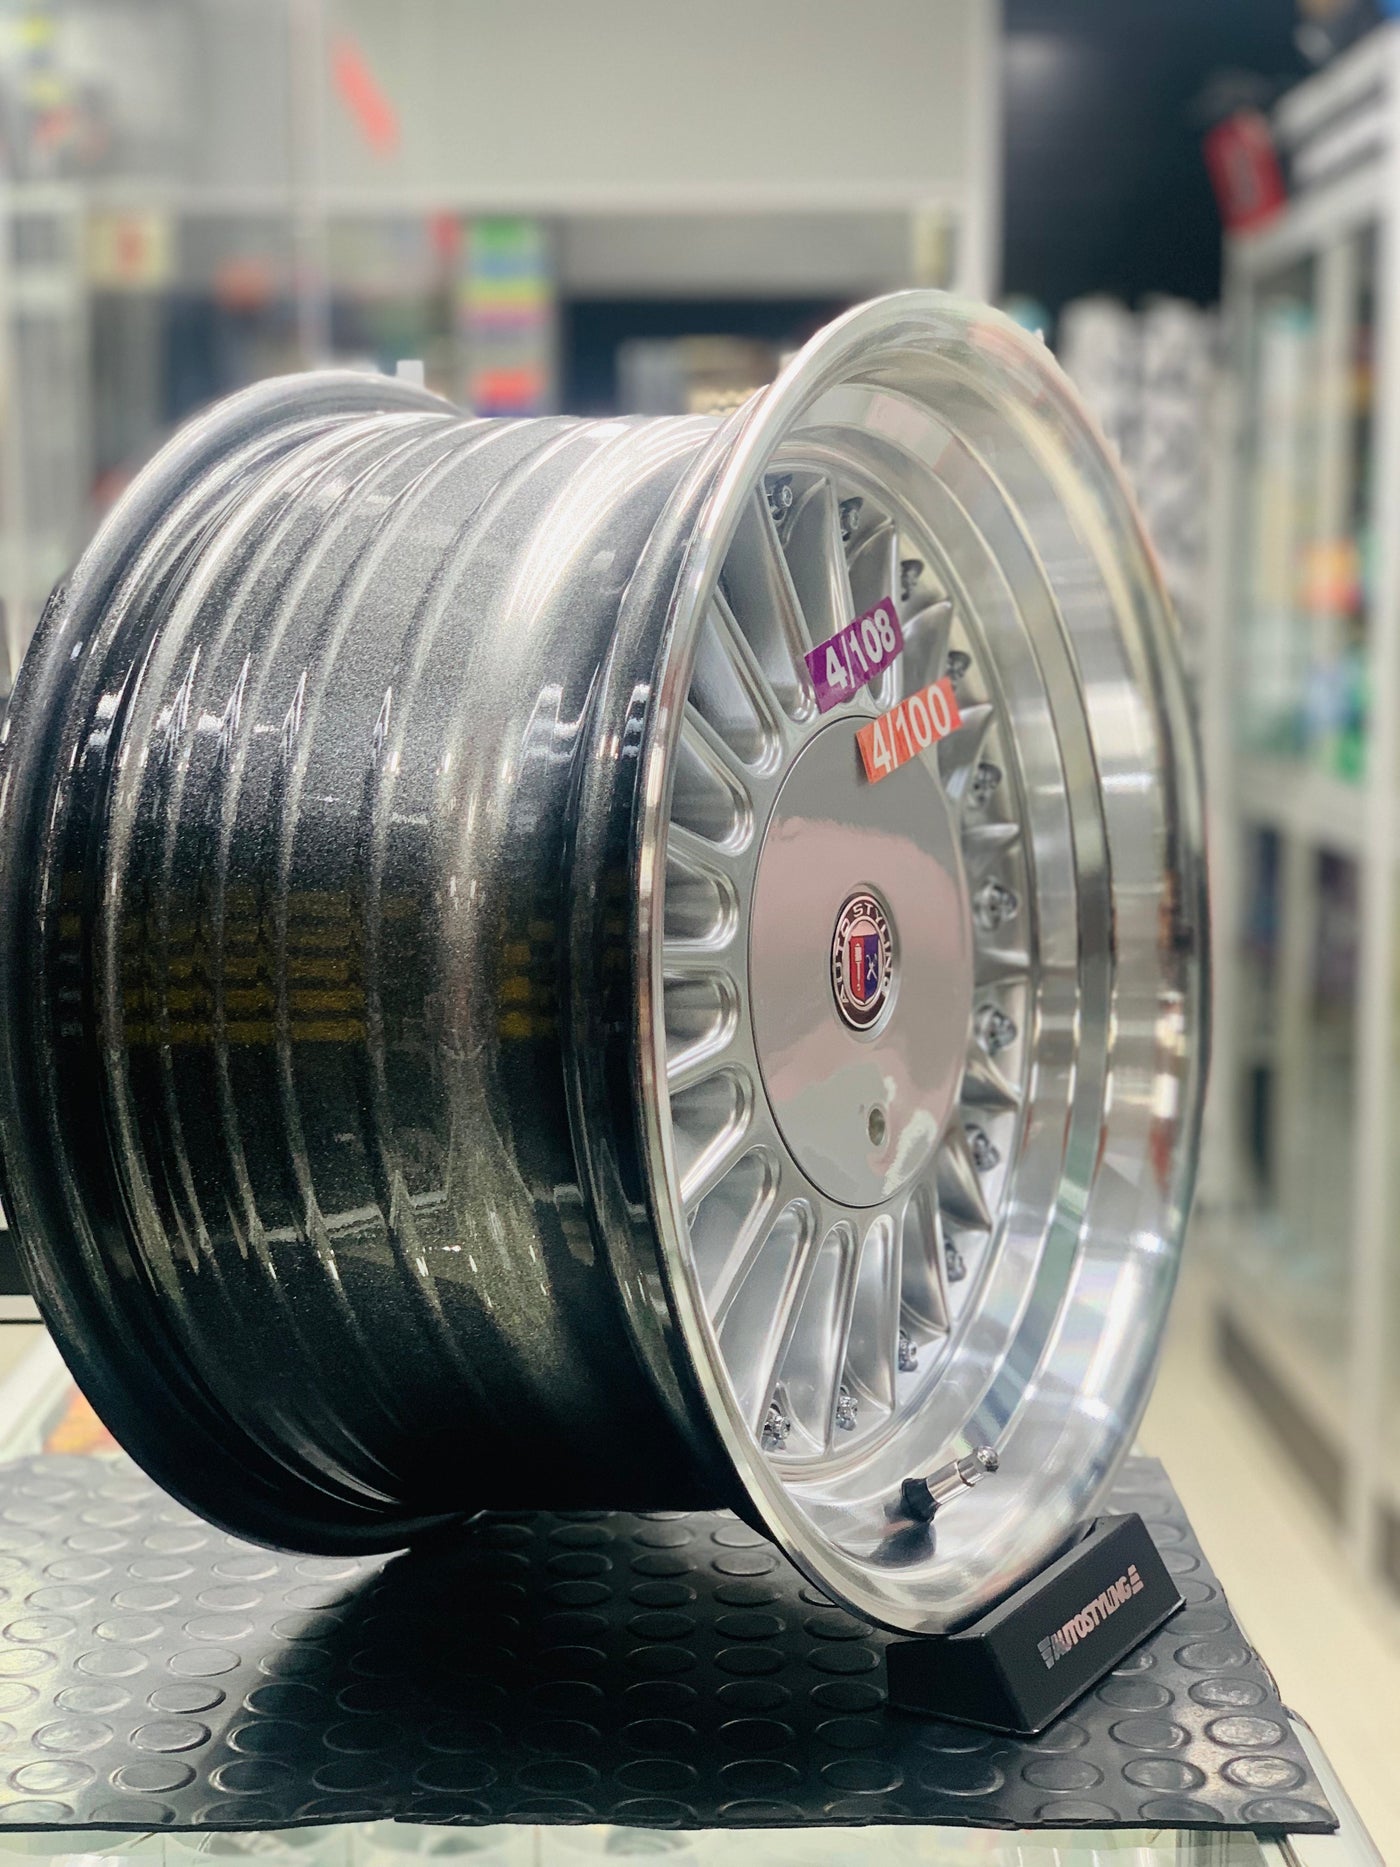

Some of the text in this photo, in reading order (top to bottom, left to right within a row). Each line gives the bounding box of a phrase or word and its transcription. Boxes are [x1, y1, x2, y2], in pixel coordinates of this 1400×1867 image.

[825, 608, 896, 689] 4/108
[872, 684, 951, 774] 4/100
[835, 902, 892, 1004] AUTO STYLING
[1049, 1575, 1133, 1661] AUTOSTYLING
